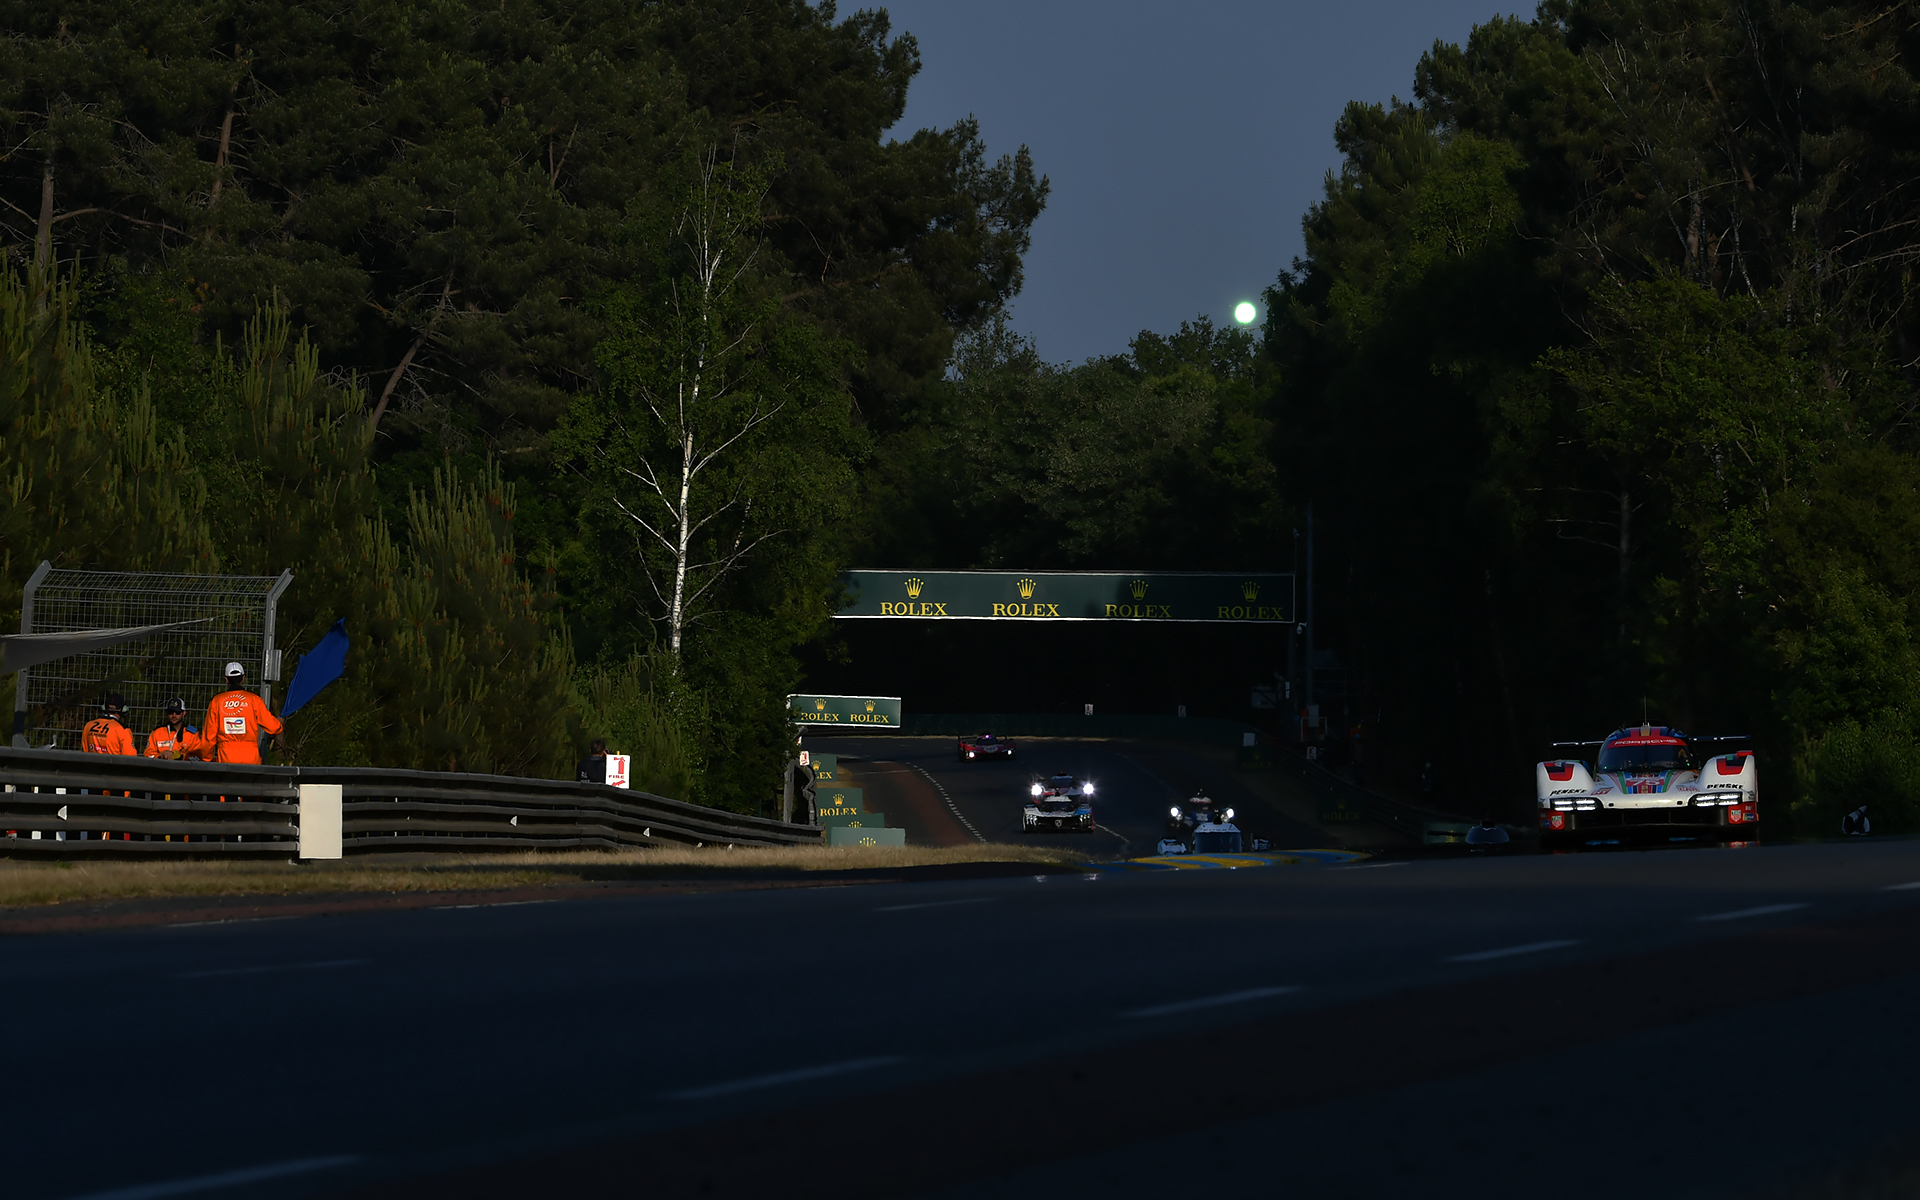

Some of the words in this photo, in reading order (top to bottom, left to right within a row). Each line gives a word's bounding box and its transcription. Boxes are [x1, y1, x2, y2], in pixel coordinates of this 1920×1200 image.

[880, 602, 948, 617] ROLEX
[992, 603, 1060, 618] ROLEX
[1105, 604, 1172, 619] ROLEX
[1217, 606, 1284, 620] ROLEX
[850, 714, 889, 723] ROLEX
[820, 808, 857, 816] ROLEX
